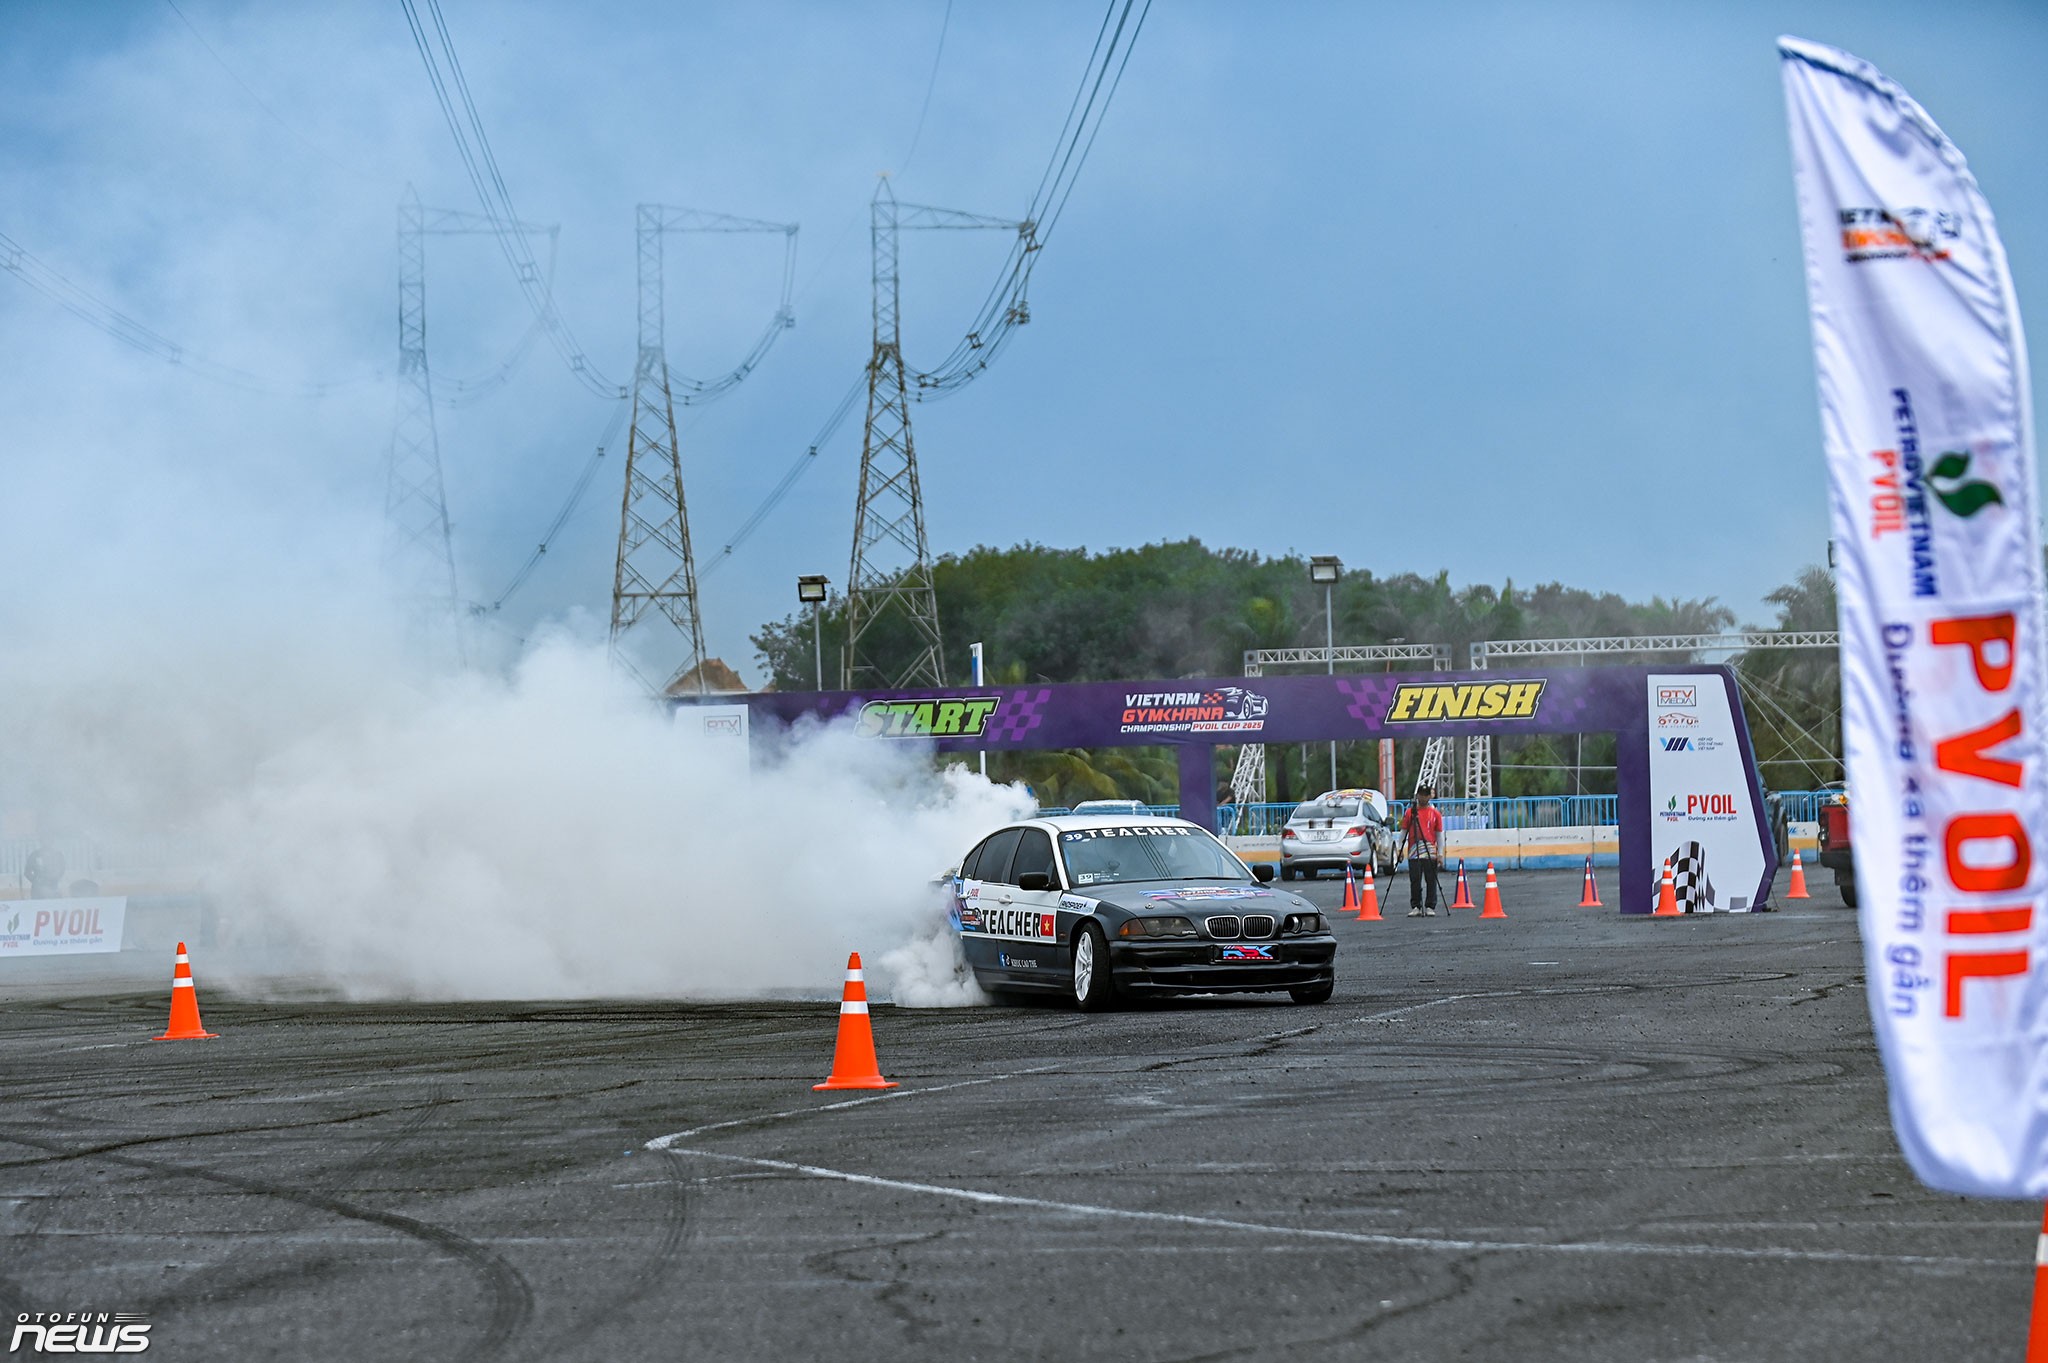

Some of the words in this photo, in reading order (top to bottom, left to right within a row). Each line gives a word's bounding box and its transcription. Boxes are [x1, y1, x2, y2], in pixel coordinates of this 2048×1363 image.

[1870, 449, 1907, 540] PVOIL
[1125, 692, 1200, 706] VIETNAM
[1390, 683, 1541, 720] FINISH
[856, 701, 994, 736] START
[1120, 723, 1191, 733] CHAMPIONSHIP
[1193, 722, 1219, 731] PVOIL
[1221, 722, 1240, 730] CUP
[1242, 721, 1262, 730] 2025
[1122, 707, 1224, 723] GYMKHANA
[1687, 794, 1737, 814] PVOIL
[1927, 611, 2034, 1022] PVOIL
[1065, 833, 1083, 841] 39
[1085, 827, 1191, 838] TEACHER
[1898, 831, 1931, 933] thêm
[33, 908, 103, 937] PVOIL
[983, 909, 1040, 937] TEACHER
